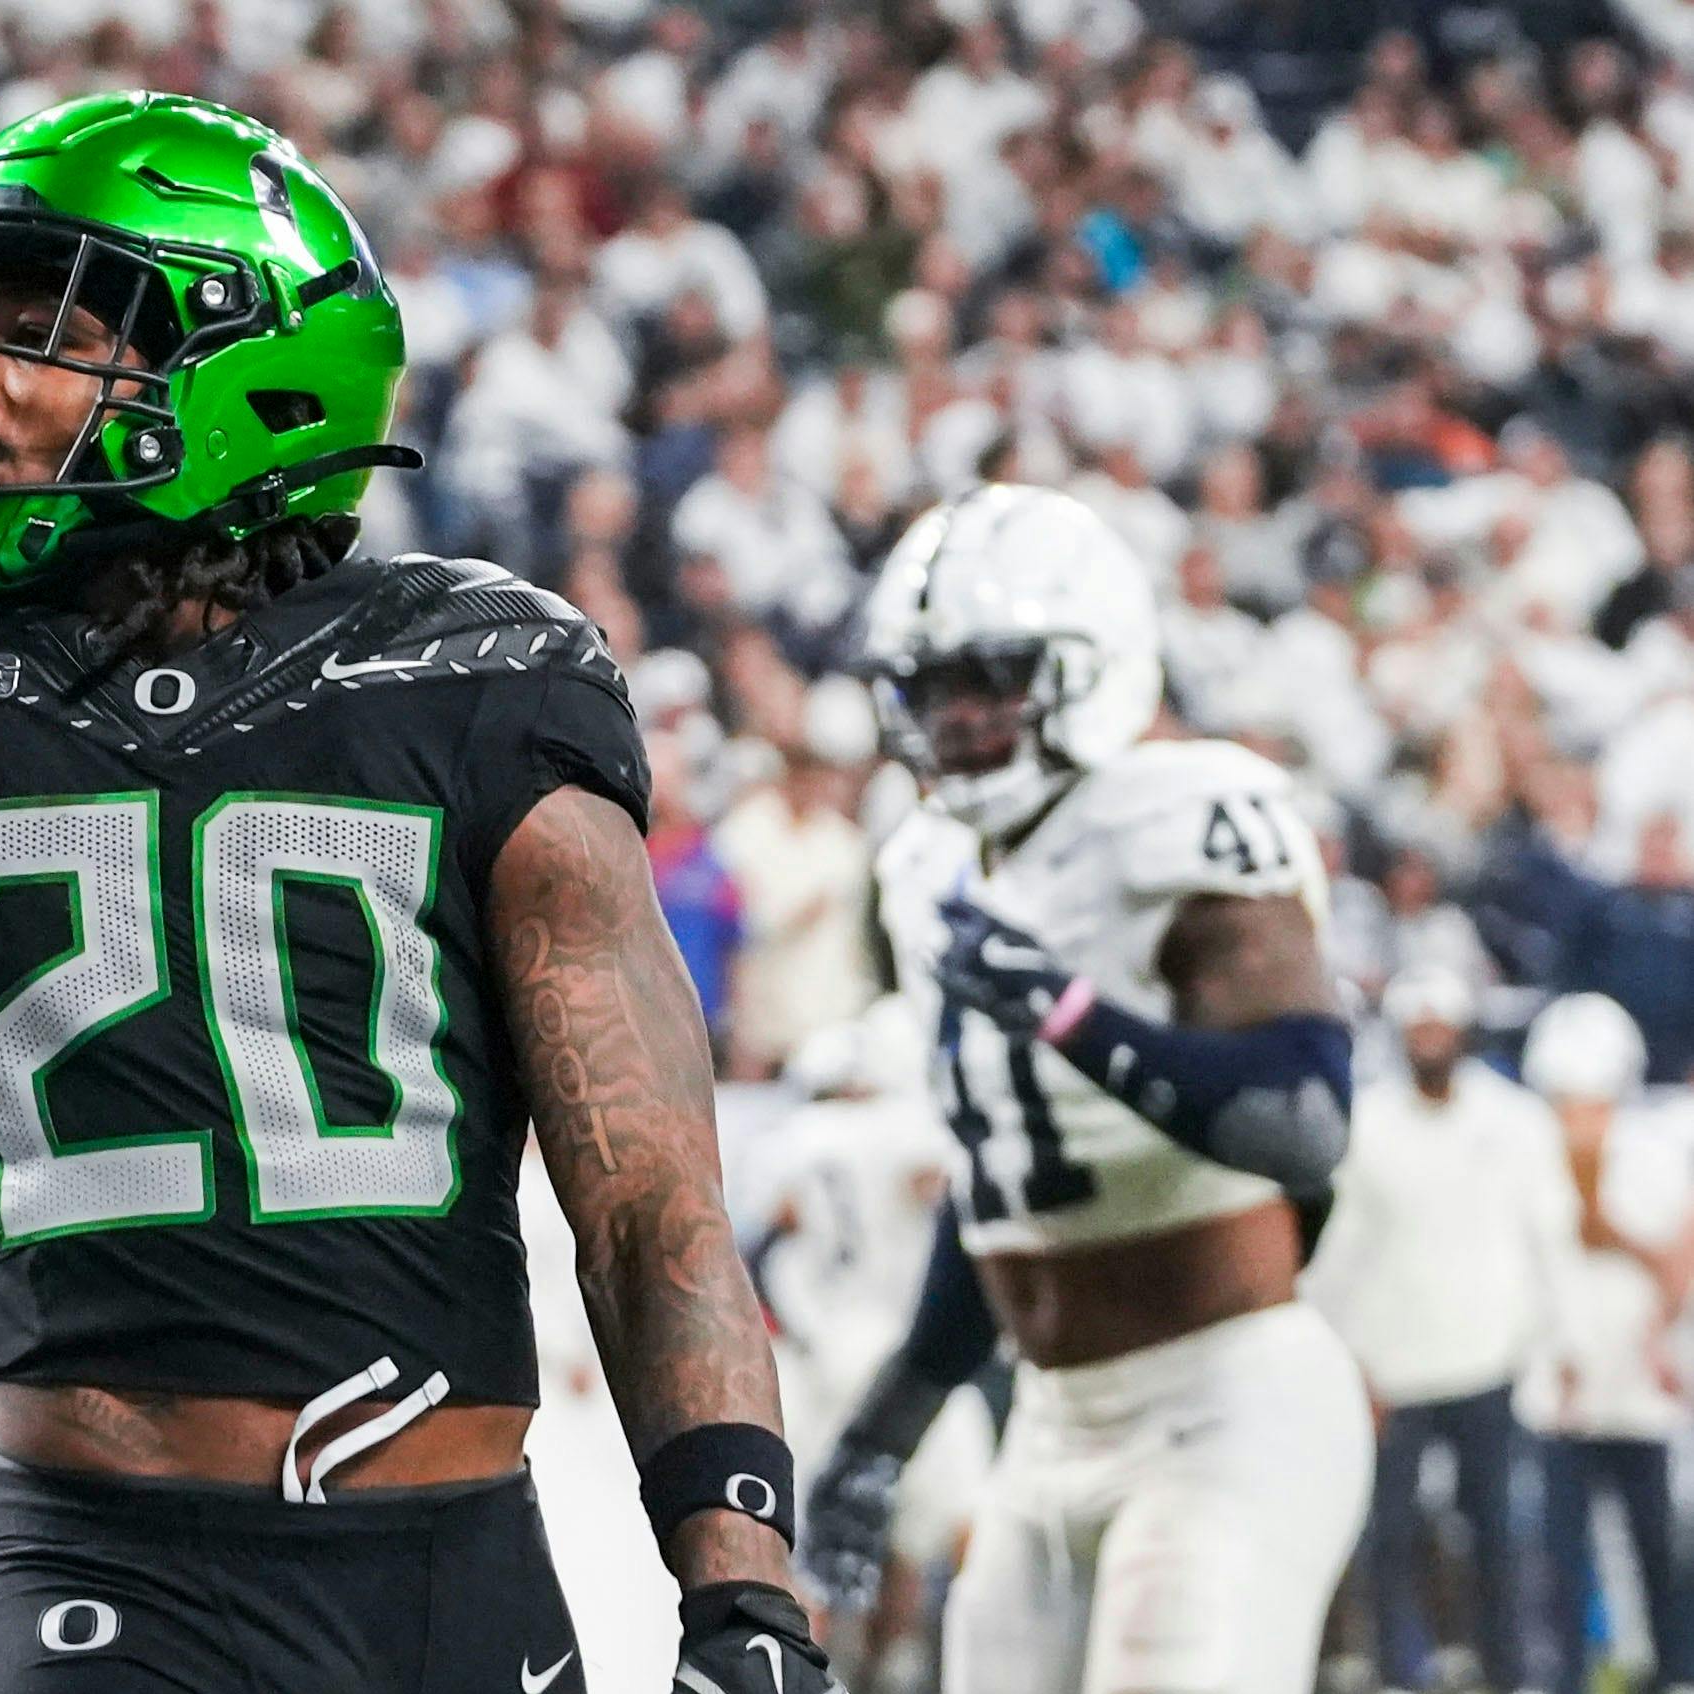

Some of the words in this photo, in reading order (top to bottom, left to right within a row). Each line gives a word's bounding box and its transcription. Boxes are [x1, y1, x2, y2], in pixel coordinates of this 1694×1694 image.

[134, 668, 196, 715] O
[1202, 795, 1290, 875] 41
[726, 1472, 777, 1519] O
[36, 1599, 122, 1652] O
